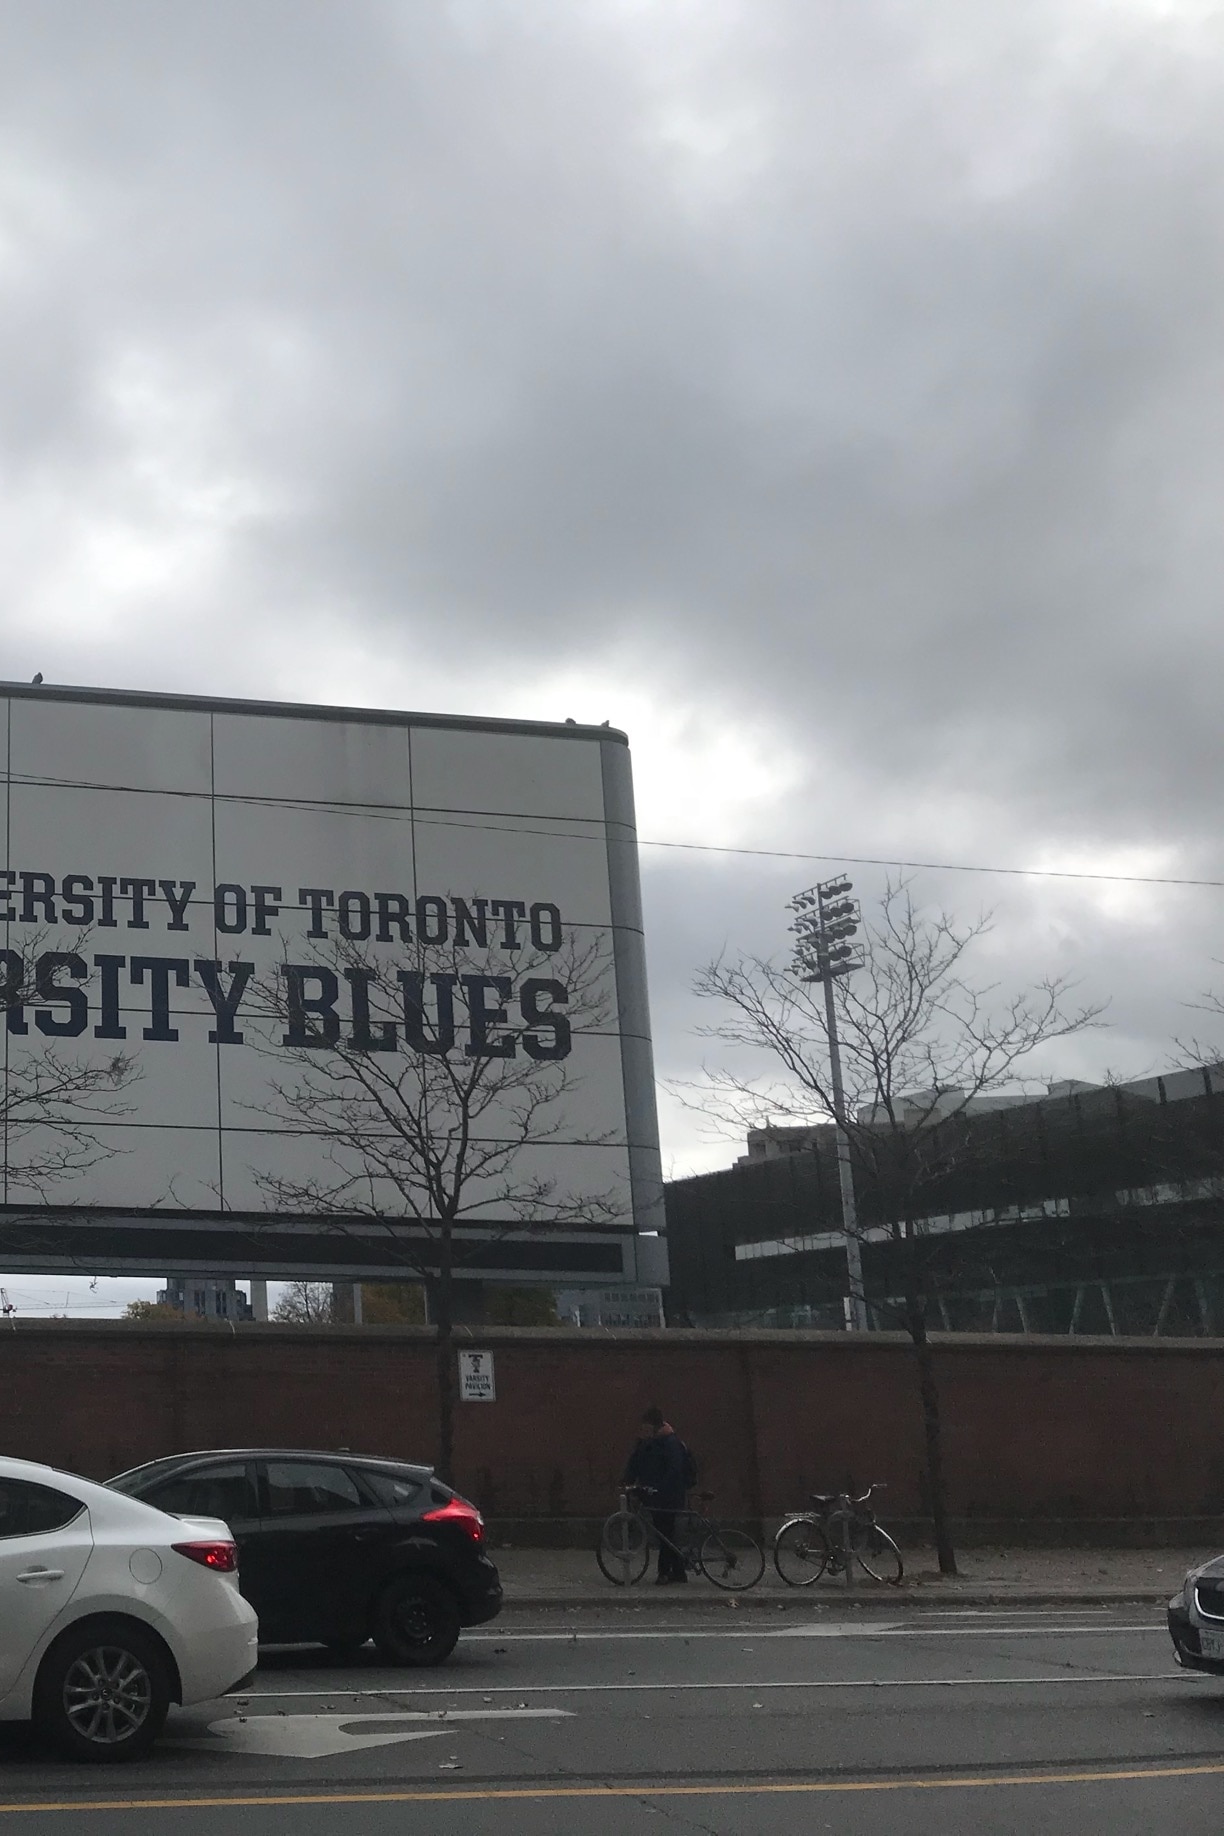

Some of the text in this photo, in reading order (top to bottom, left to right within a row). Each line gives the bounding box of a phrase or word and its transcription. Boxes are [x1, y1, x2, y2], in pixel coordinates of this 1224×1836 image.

[214, 883, 282, 936] OF
[298, 888, 563, 952] TORONTO
[282, 965, 573, 1061] BLUES
